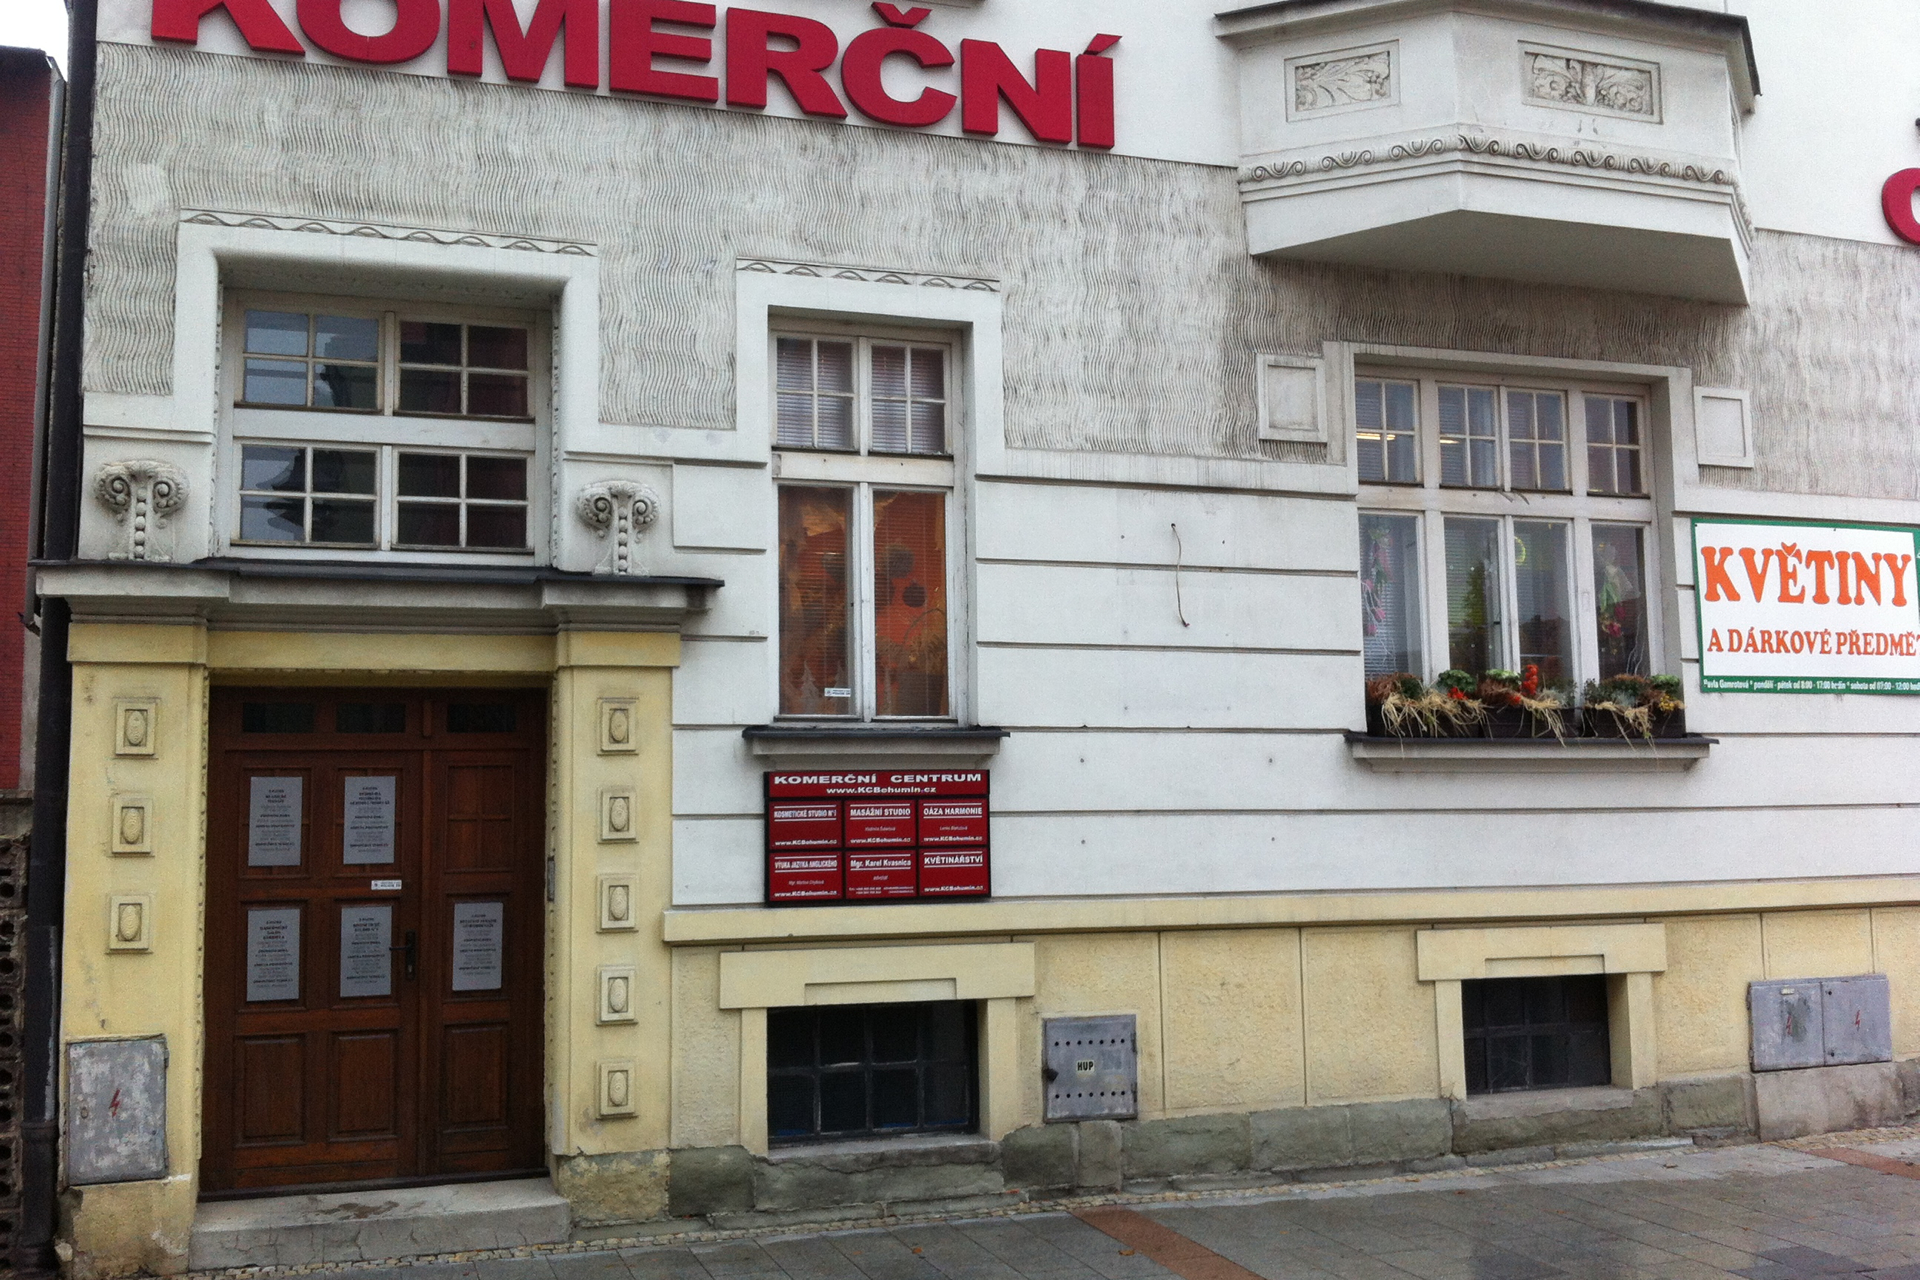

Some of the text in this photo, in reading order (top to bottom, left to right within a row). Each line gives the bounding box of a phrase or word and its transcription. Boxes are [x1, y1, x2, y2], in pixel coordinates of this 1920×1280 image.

[1701, 542, 1912, 607] KVĚTINY
[1707, 628, 1724, 652] A
[1727, 626, 1833, 655] DÁRKOVÉ
[774, 773, 982, 785] KOMERČNÍ CENTRUM
[850, 806, 911, 817] MASÁŽNÍ STUDIO
[923, 805, 983, 816] OÁZA HARMONIE
[865, 858, 882, 868] Karel
[924, 853, 984, 865] KVĚTINÁŘSTVÍ
[1077, 1061, 1094, 1071] HUP
